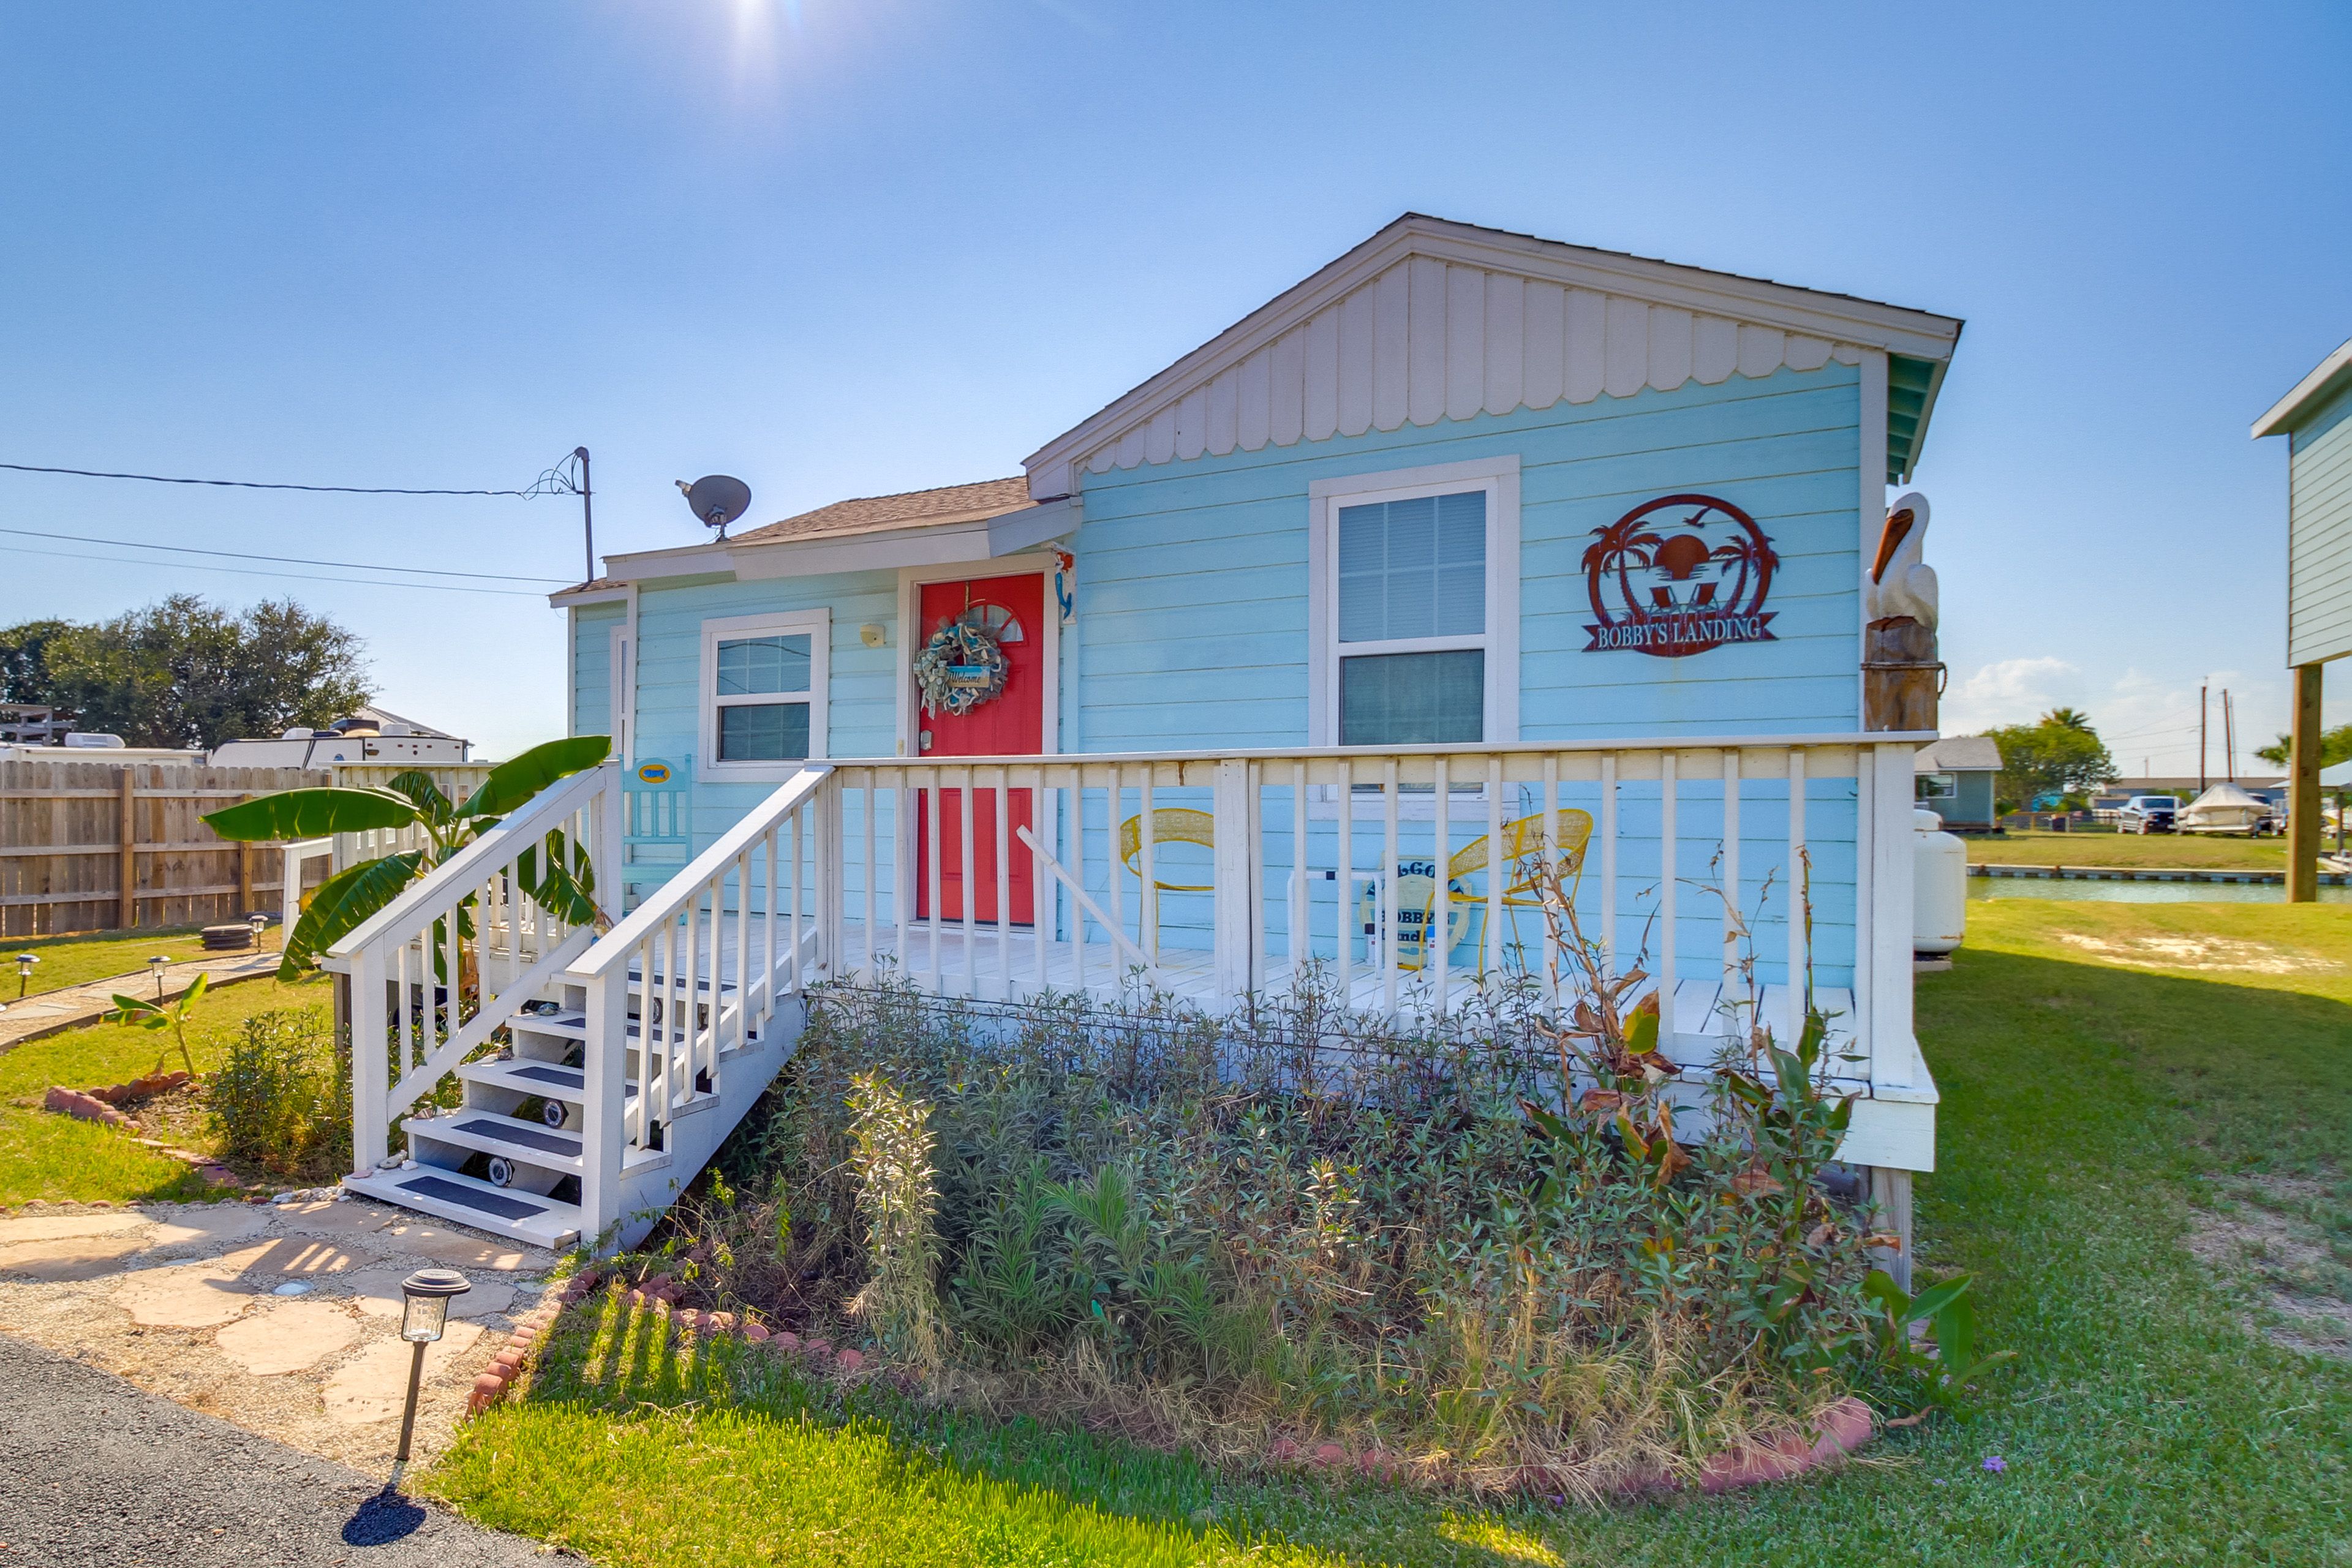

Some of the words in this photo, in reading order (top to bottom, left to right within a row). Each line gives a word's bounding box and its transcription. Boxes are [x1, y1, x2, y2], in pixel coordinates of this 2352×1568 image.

[1597, 622, 1668, 648] BOBBY'S
[1673, 616, 1762, 643] LANDING
[949, 671, 981, 683] Welcome
